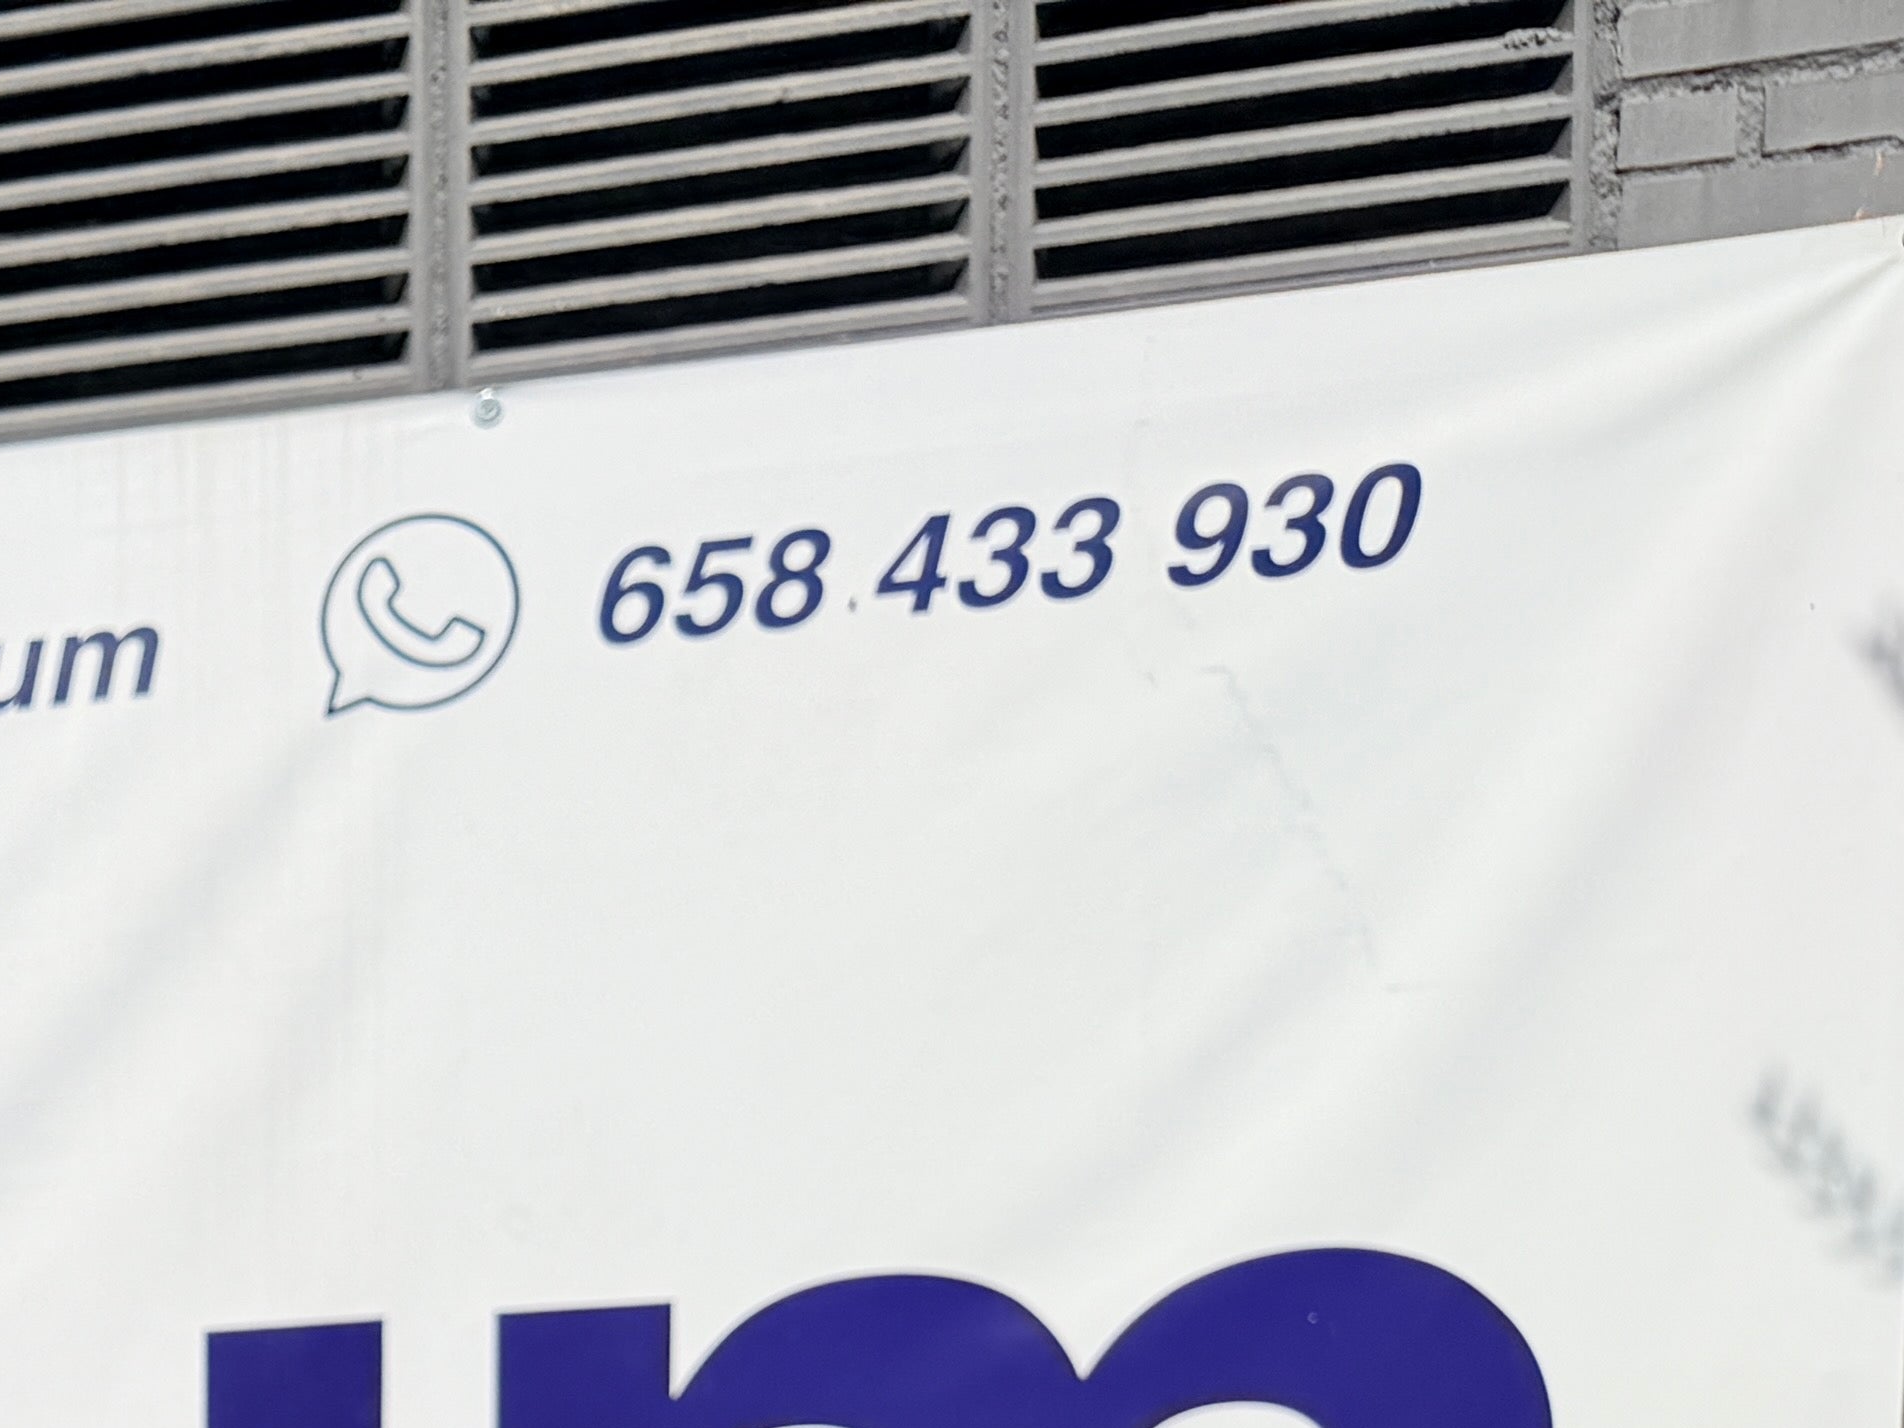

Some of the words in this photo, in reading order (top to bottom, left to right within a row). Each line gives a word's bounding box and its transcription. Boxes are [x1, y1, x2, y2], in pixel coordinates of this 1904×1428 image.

[597, 527, 832, 646] 658
[875, 496, 1122, 615] 433
[1166, 461, 1423, 588] 930
